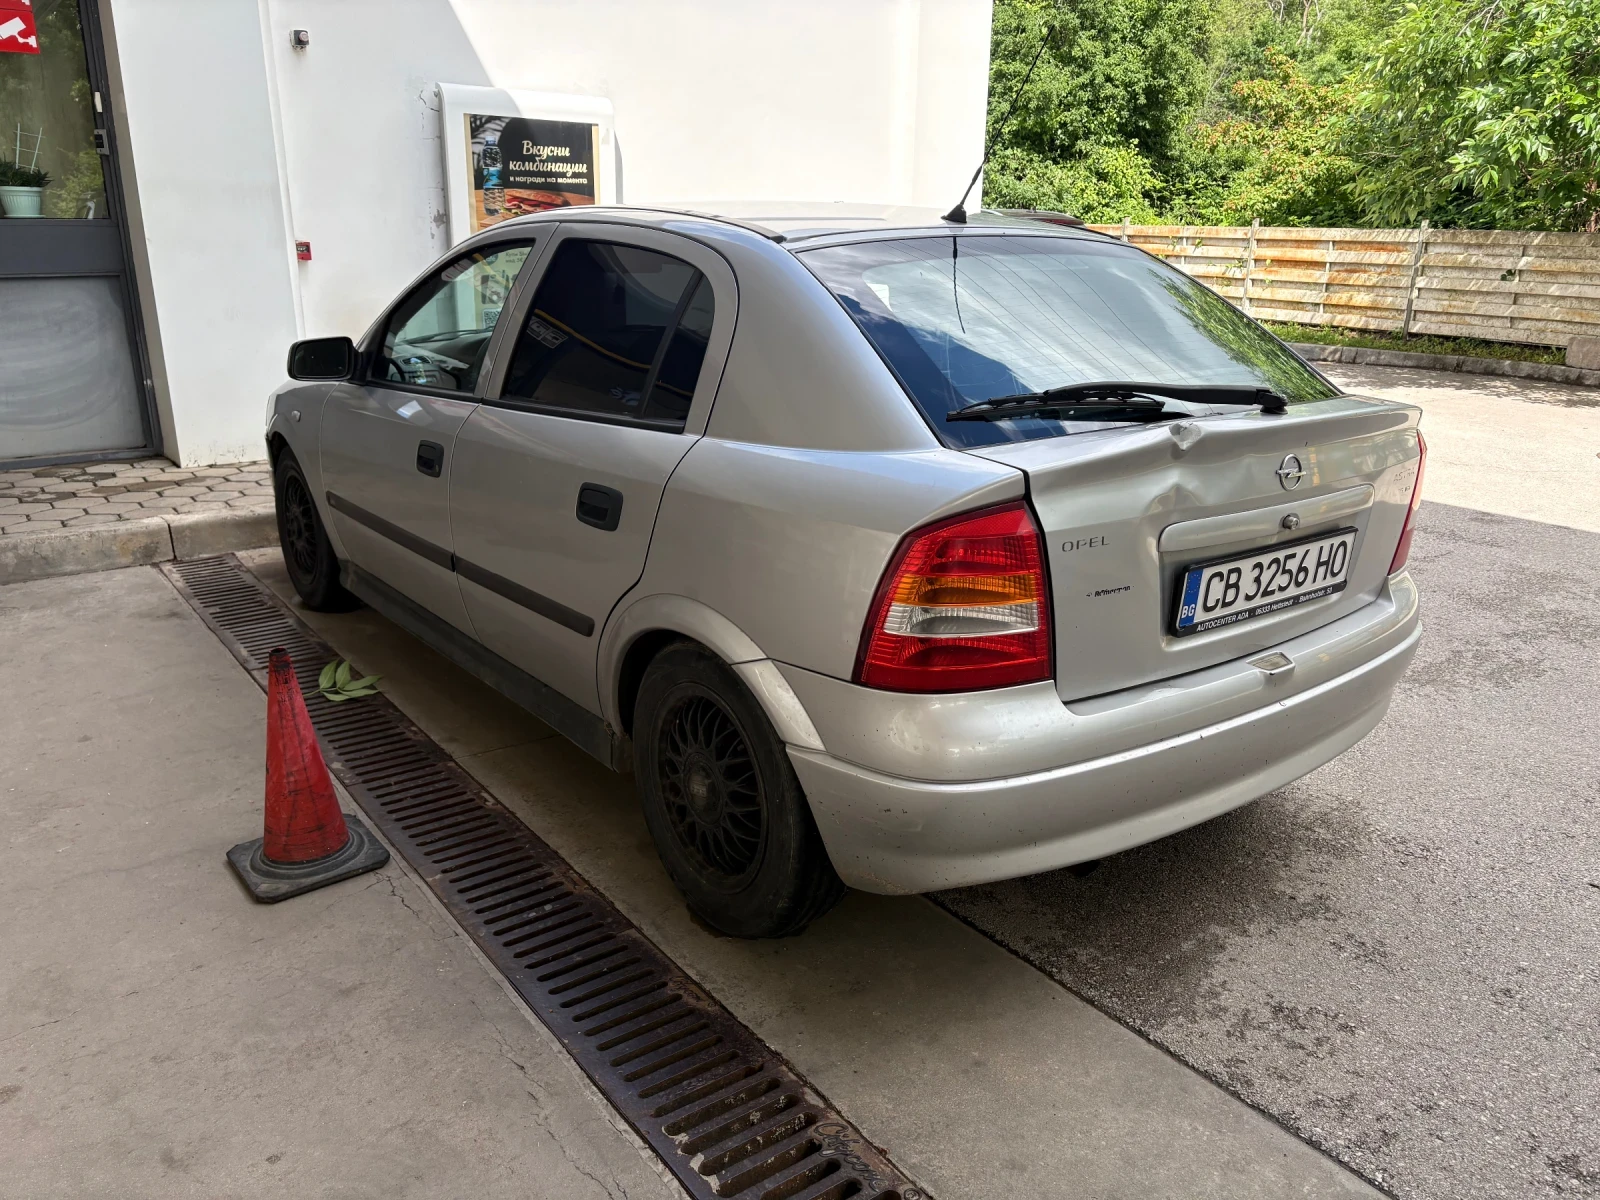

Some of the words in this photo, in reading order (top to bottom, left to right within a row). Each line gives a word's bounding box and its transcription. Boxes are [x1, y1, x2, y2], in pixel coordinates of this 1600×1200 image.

[522, 140, 570, 159] Вкусни
[509, 157, 588, 177] комбинации
[515, 176, 546, 185] награди
[1061, 536, 1111, 553] OPEL
[1202, 566, 1243, 613] CB
[1244, 548, 1311, 602] 3256
[1312, 540, 1348, 584] HO
[1181, 603, 1196, 619] BG
[1196, 614, 1237, 632] AUTOCENTER
[1236, 611, 1249, 621] ADA
